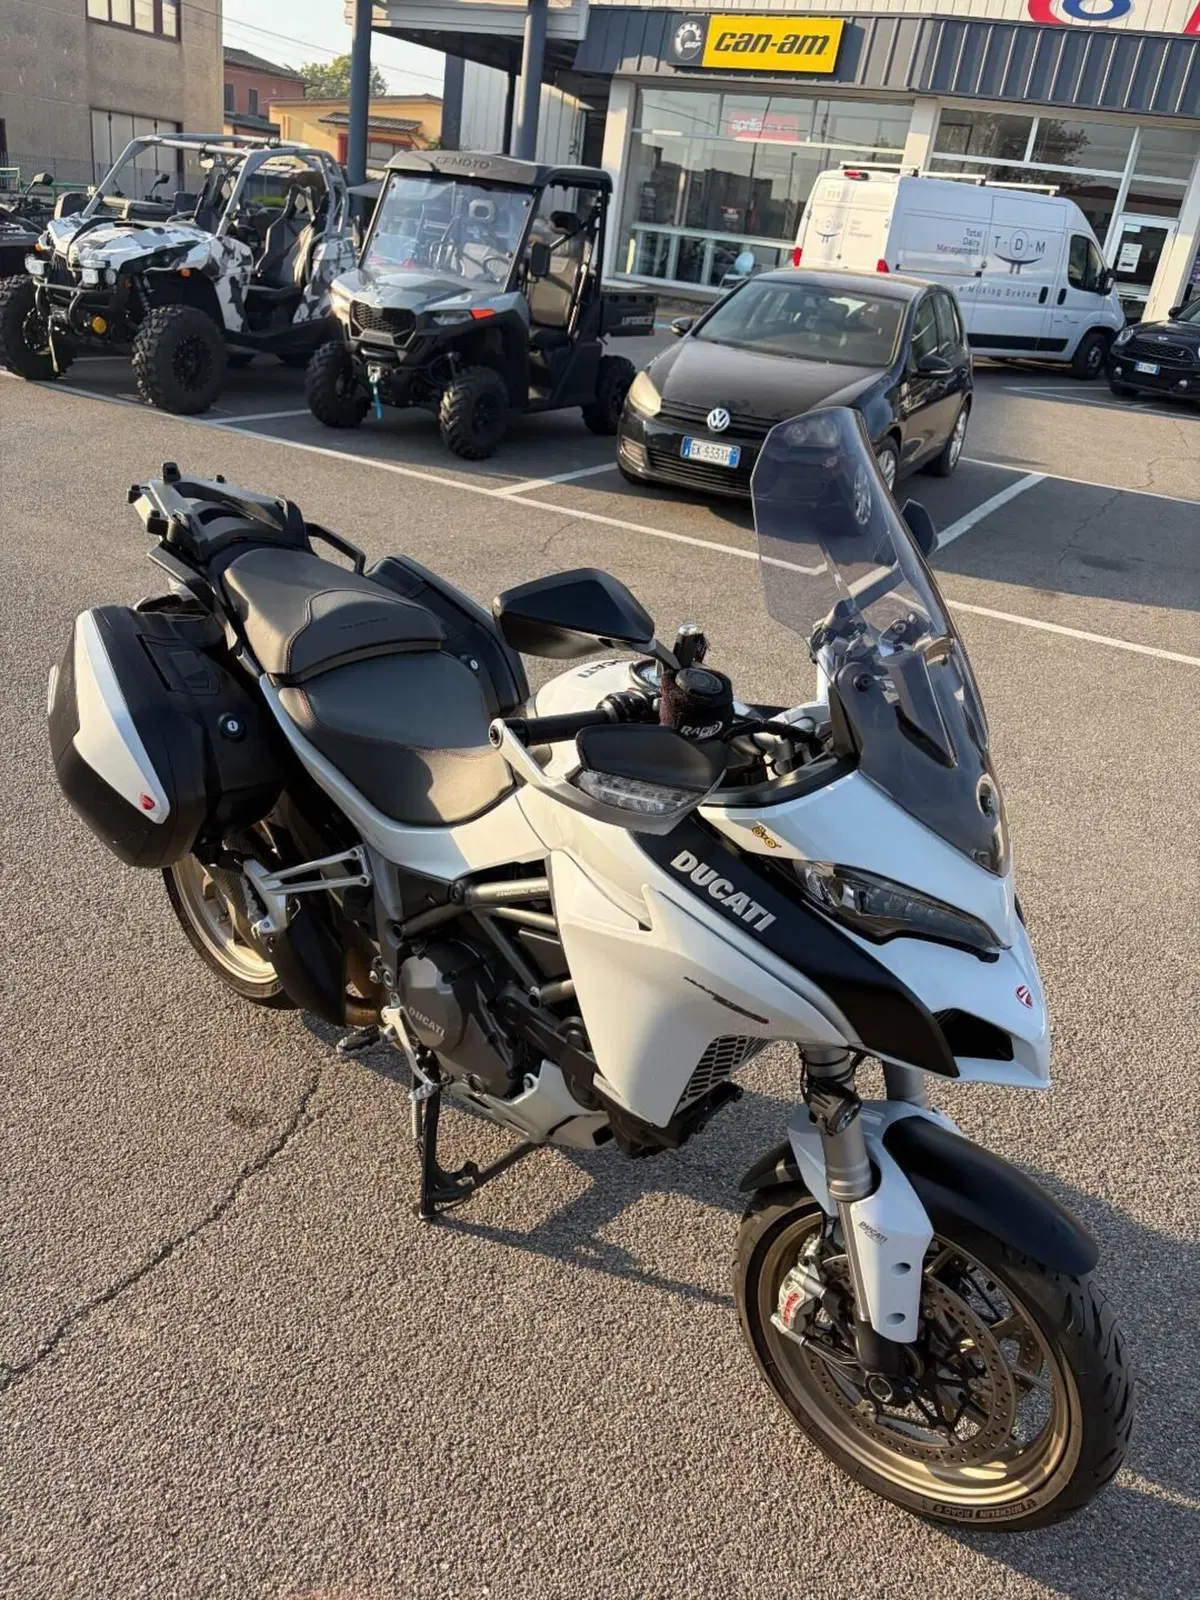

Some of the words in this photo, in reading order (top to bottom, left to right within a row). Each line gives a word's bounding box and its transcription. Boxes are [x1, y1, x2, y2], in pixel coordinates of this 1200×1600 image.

[714, 32, 830, 56] can-am
[670, 849, 777, 932] DUCATI
[409, 1006, 445, 1037] DUCATI
[979, 1502, 1023, 1518] MICHELIN
